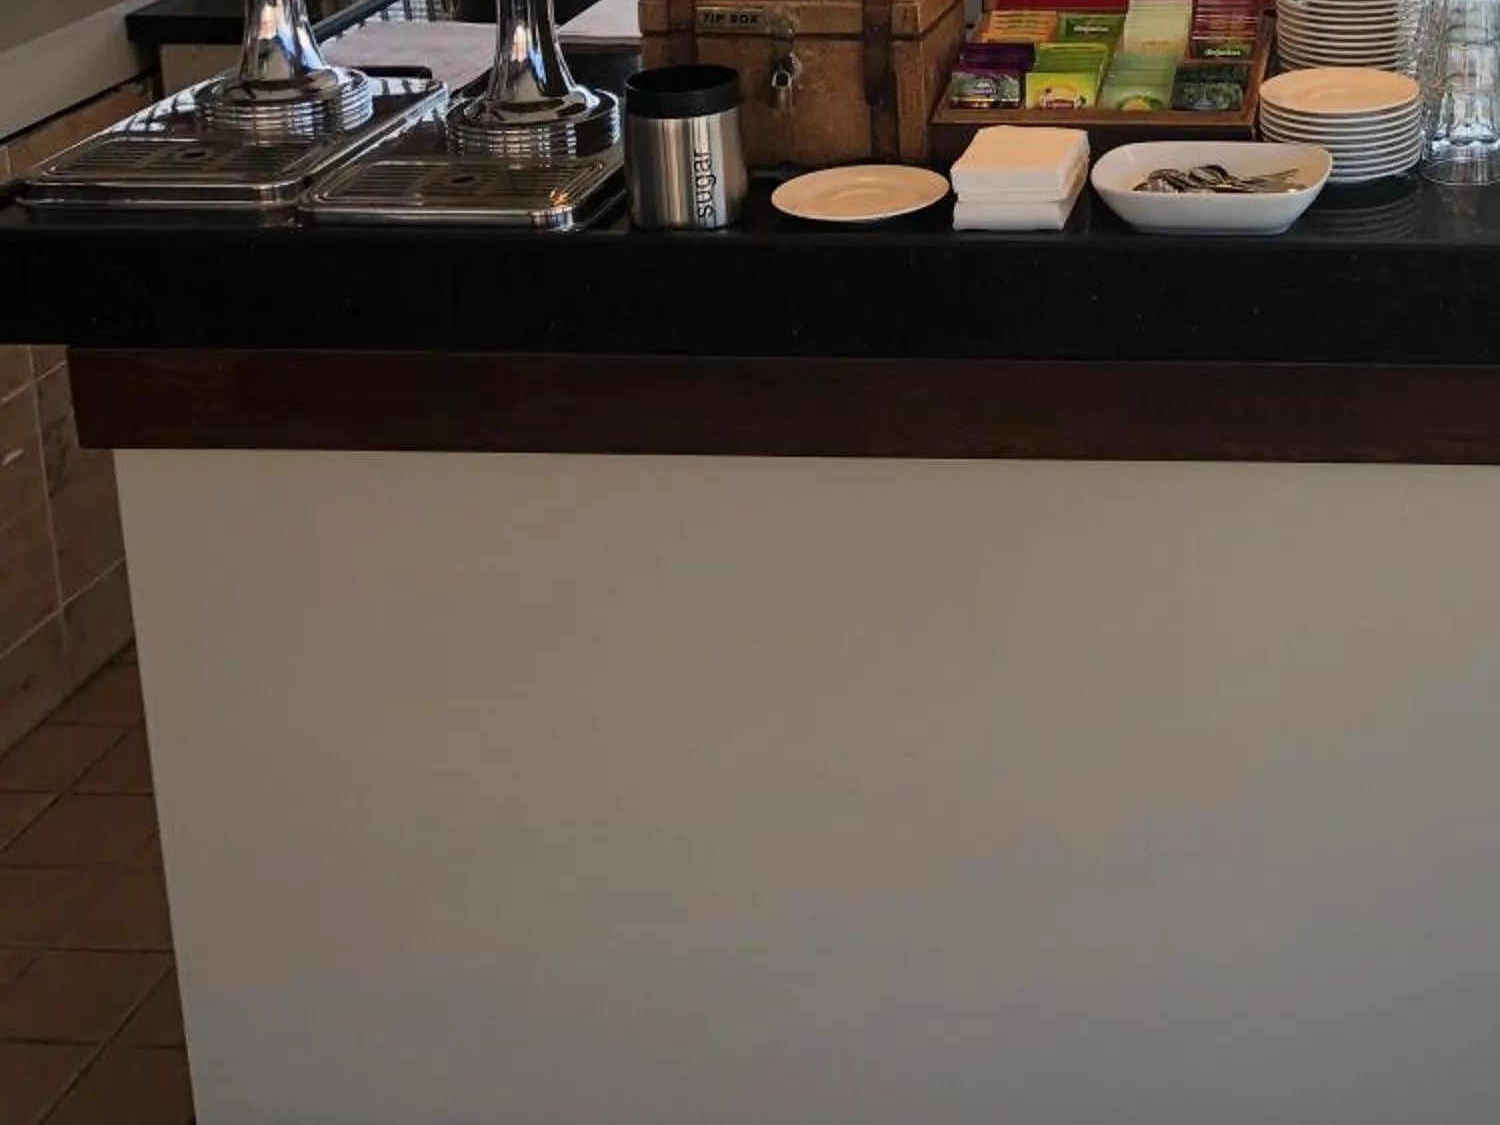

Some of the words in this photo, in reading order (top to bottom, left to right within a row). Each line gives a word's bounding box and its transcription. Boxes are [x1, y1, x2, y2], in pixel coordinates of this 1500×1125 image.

[702, 13, 725, 24] TIP
[729, 14, 759, 24] BOX
[693, 147, 717, 218] sugar
